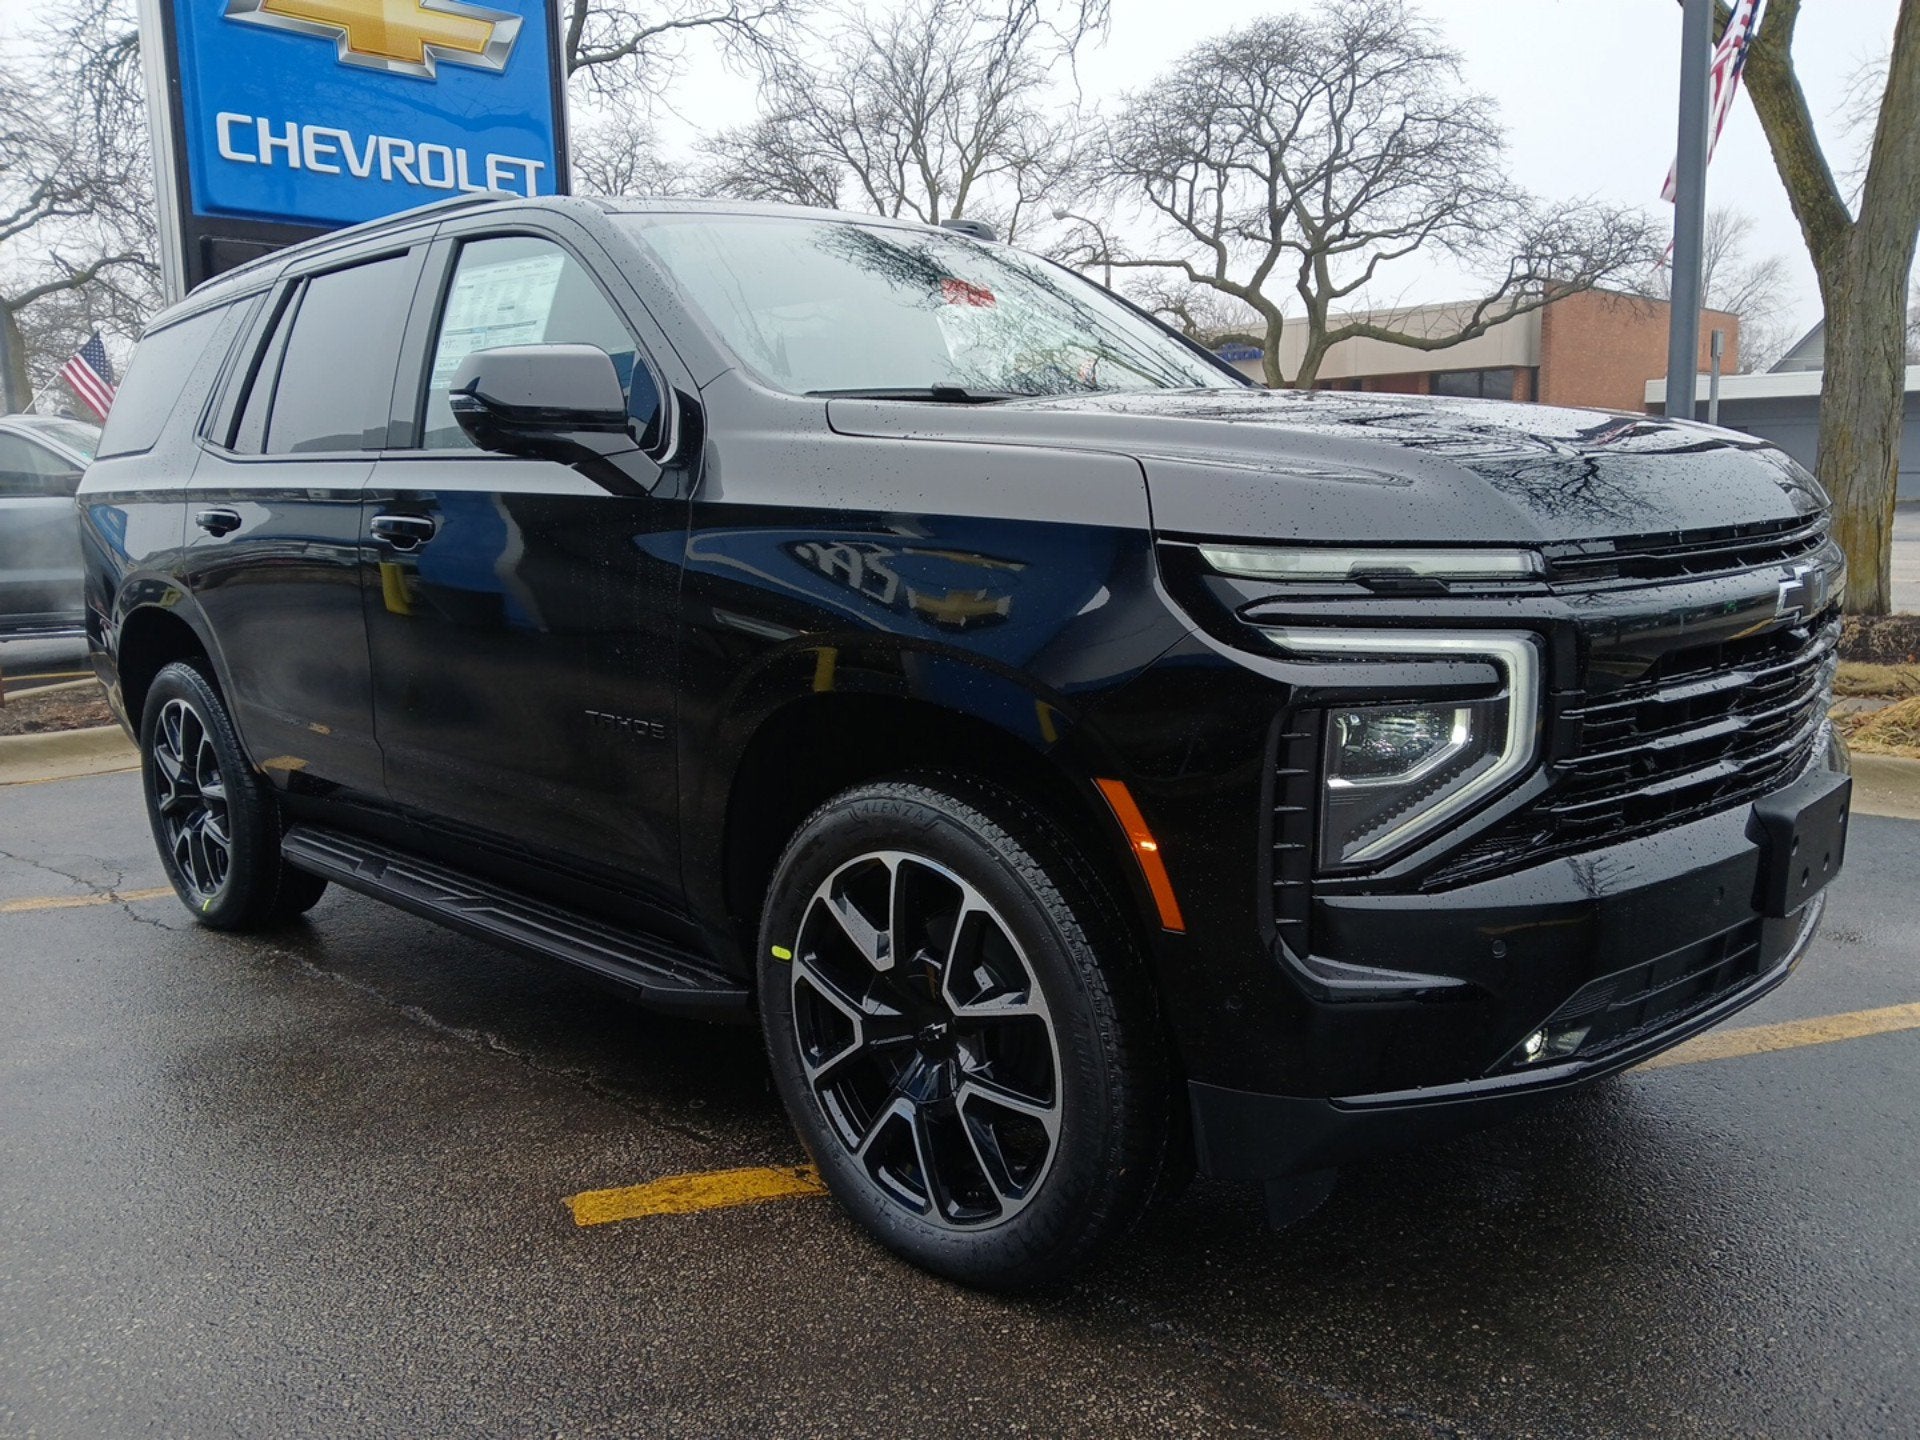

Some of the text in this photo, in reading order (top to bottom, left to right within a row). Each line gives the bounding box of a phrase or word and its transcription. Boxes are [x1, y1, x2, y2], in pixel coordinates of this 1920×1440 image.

[216, 112, 545, 199] CHEVROLET
[584, 709, 665, 740] TAHOE
[861, 802, 924, 821] ALENZA
